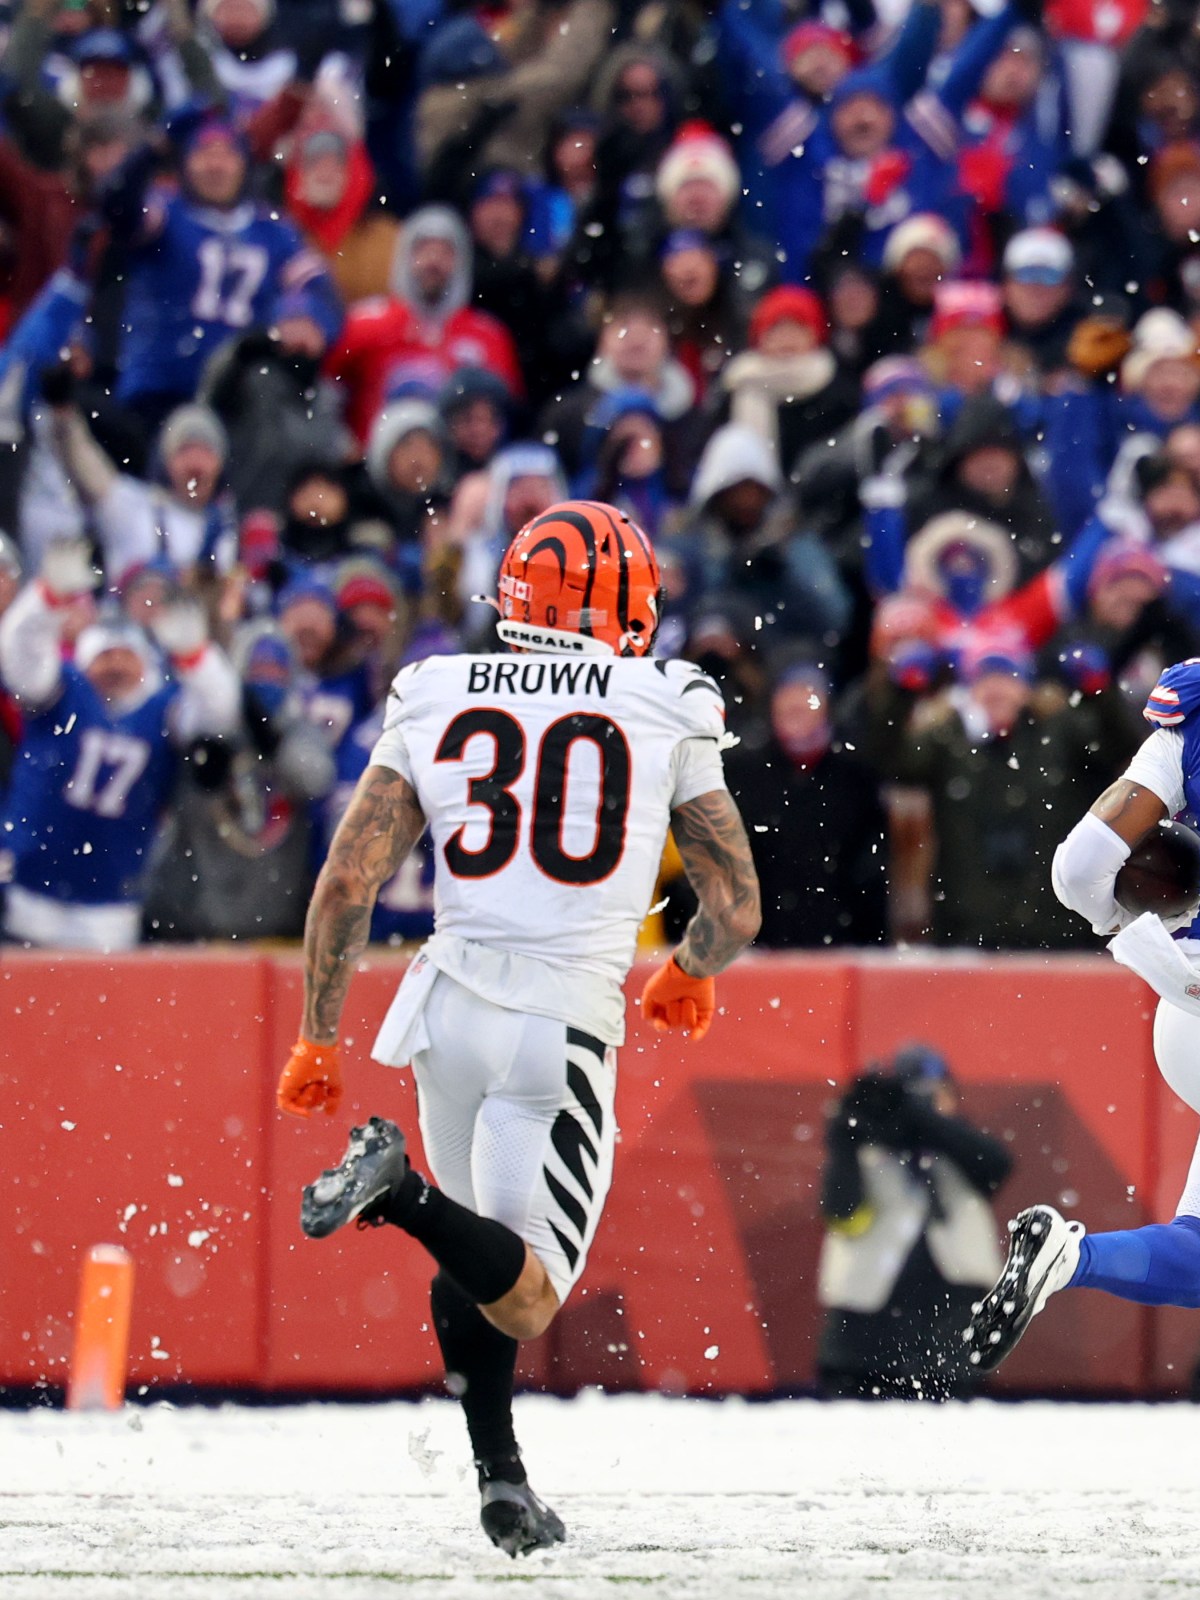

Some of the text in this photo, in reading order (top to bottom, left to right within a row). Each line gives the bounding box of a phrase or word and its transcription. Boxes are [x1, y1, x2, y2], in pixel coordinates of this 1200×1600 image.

[192, 239, 268, 327] 17
[466, 662, 613, 698] BROWN
[503, 629, 584, 651] BENGALS
[65, 728, 151, 817] 17
[434, 707, 632, 888] 30
